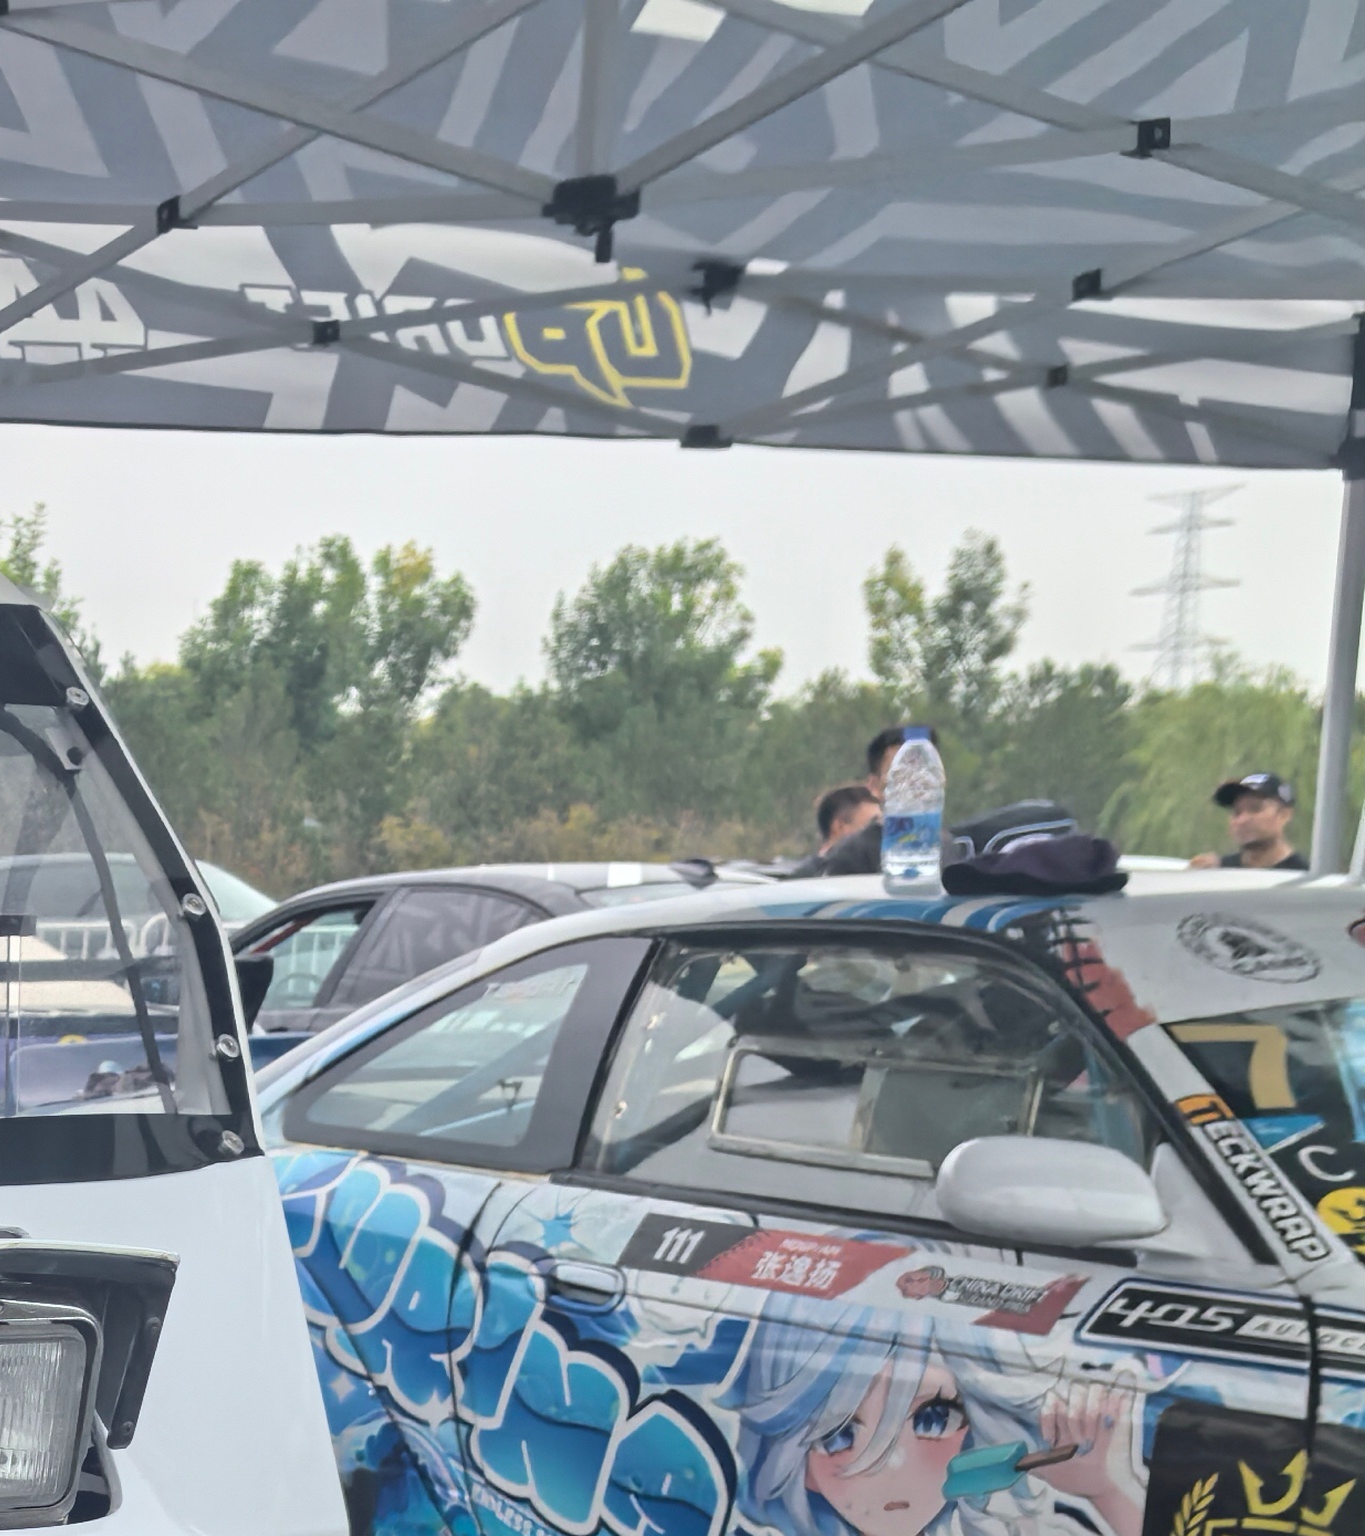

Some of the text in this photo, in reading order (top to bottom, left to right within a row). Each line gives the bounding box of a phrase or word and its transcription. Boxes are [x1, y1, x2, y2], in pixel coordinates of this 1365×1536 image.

[1174, 1092, 1331, 1262] TECKWRAP
[652, 1227, 705, 1265] 111
[1105, 1296, 1246, 1332] 405
